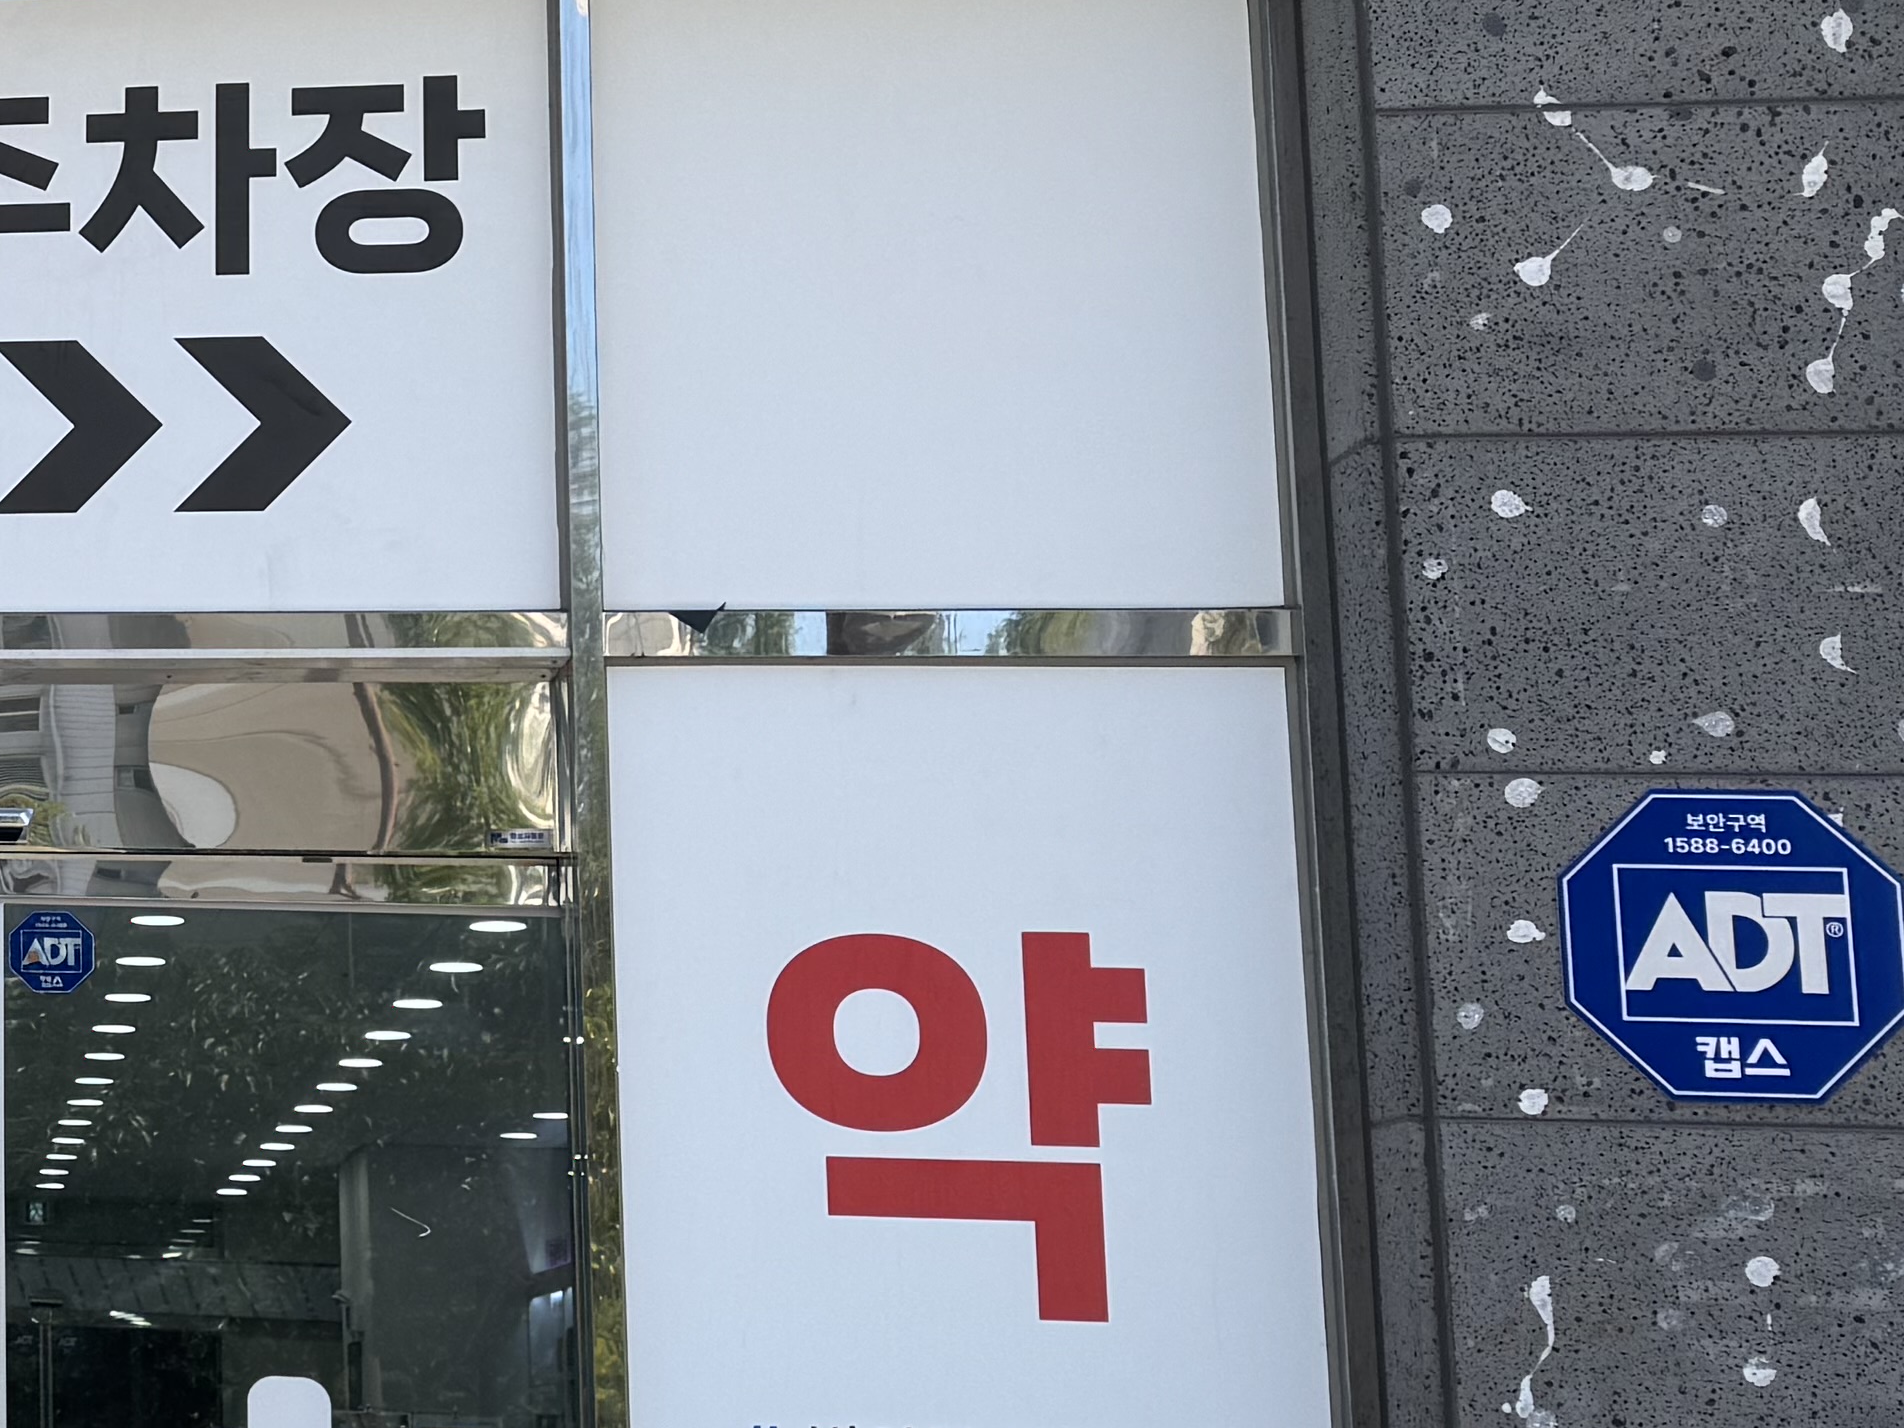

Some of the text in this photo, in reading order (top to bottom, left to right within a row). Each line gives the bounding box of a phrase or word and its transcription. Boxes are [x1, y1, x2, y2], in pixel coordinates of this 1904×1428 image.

[1685, 813, 1766, 833] 보안구역
[1663, 837, 1792, 855] 1588-6400
[22, 937, 82, 967] ADT
[1695, 1036, 1791, 1079] 캡스
[766, 931, 1152, 1323] 약
